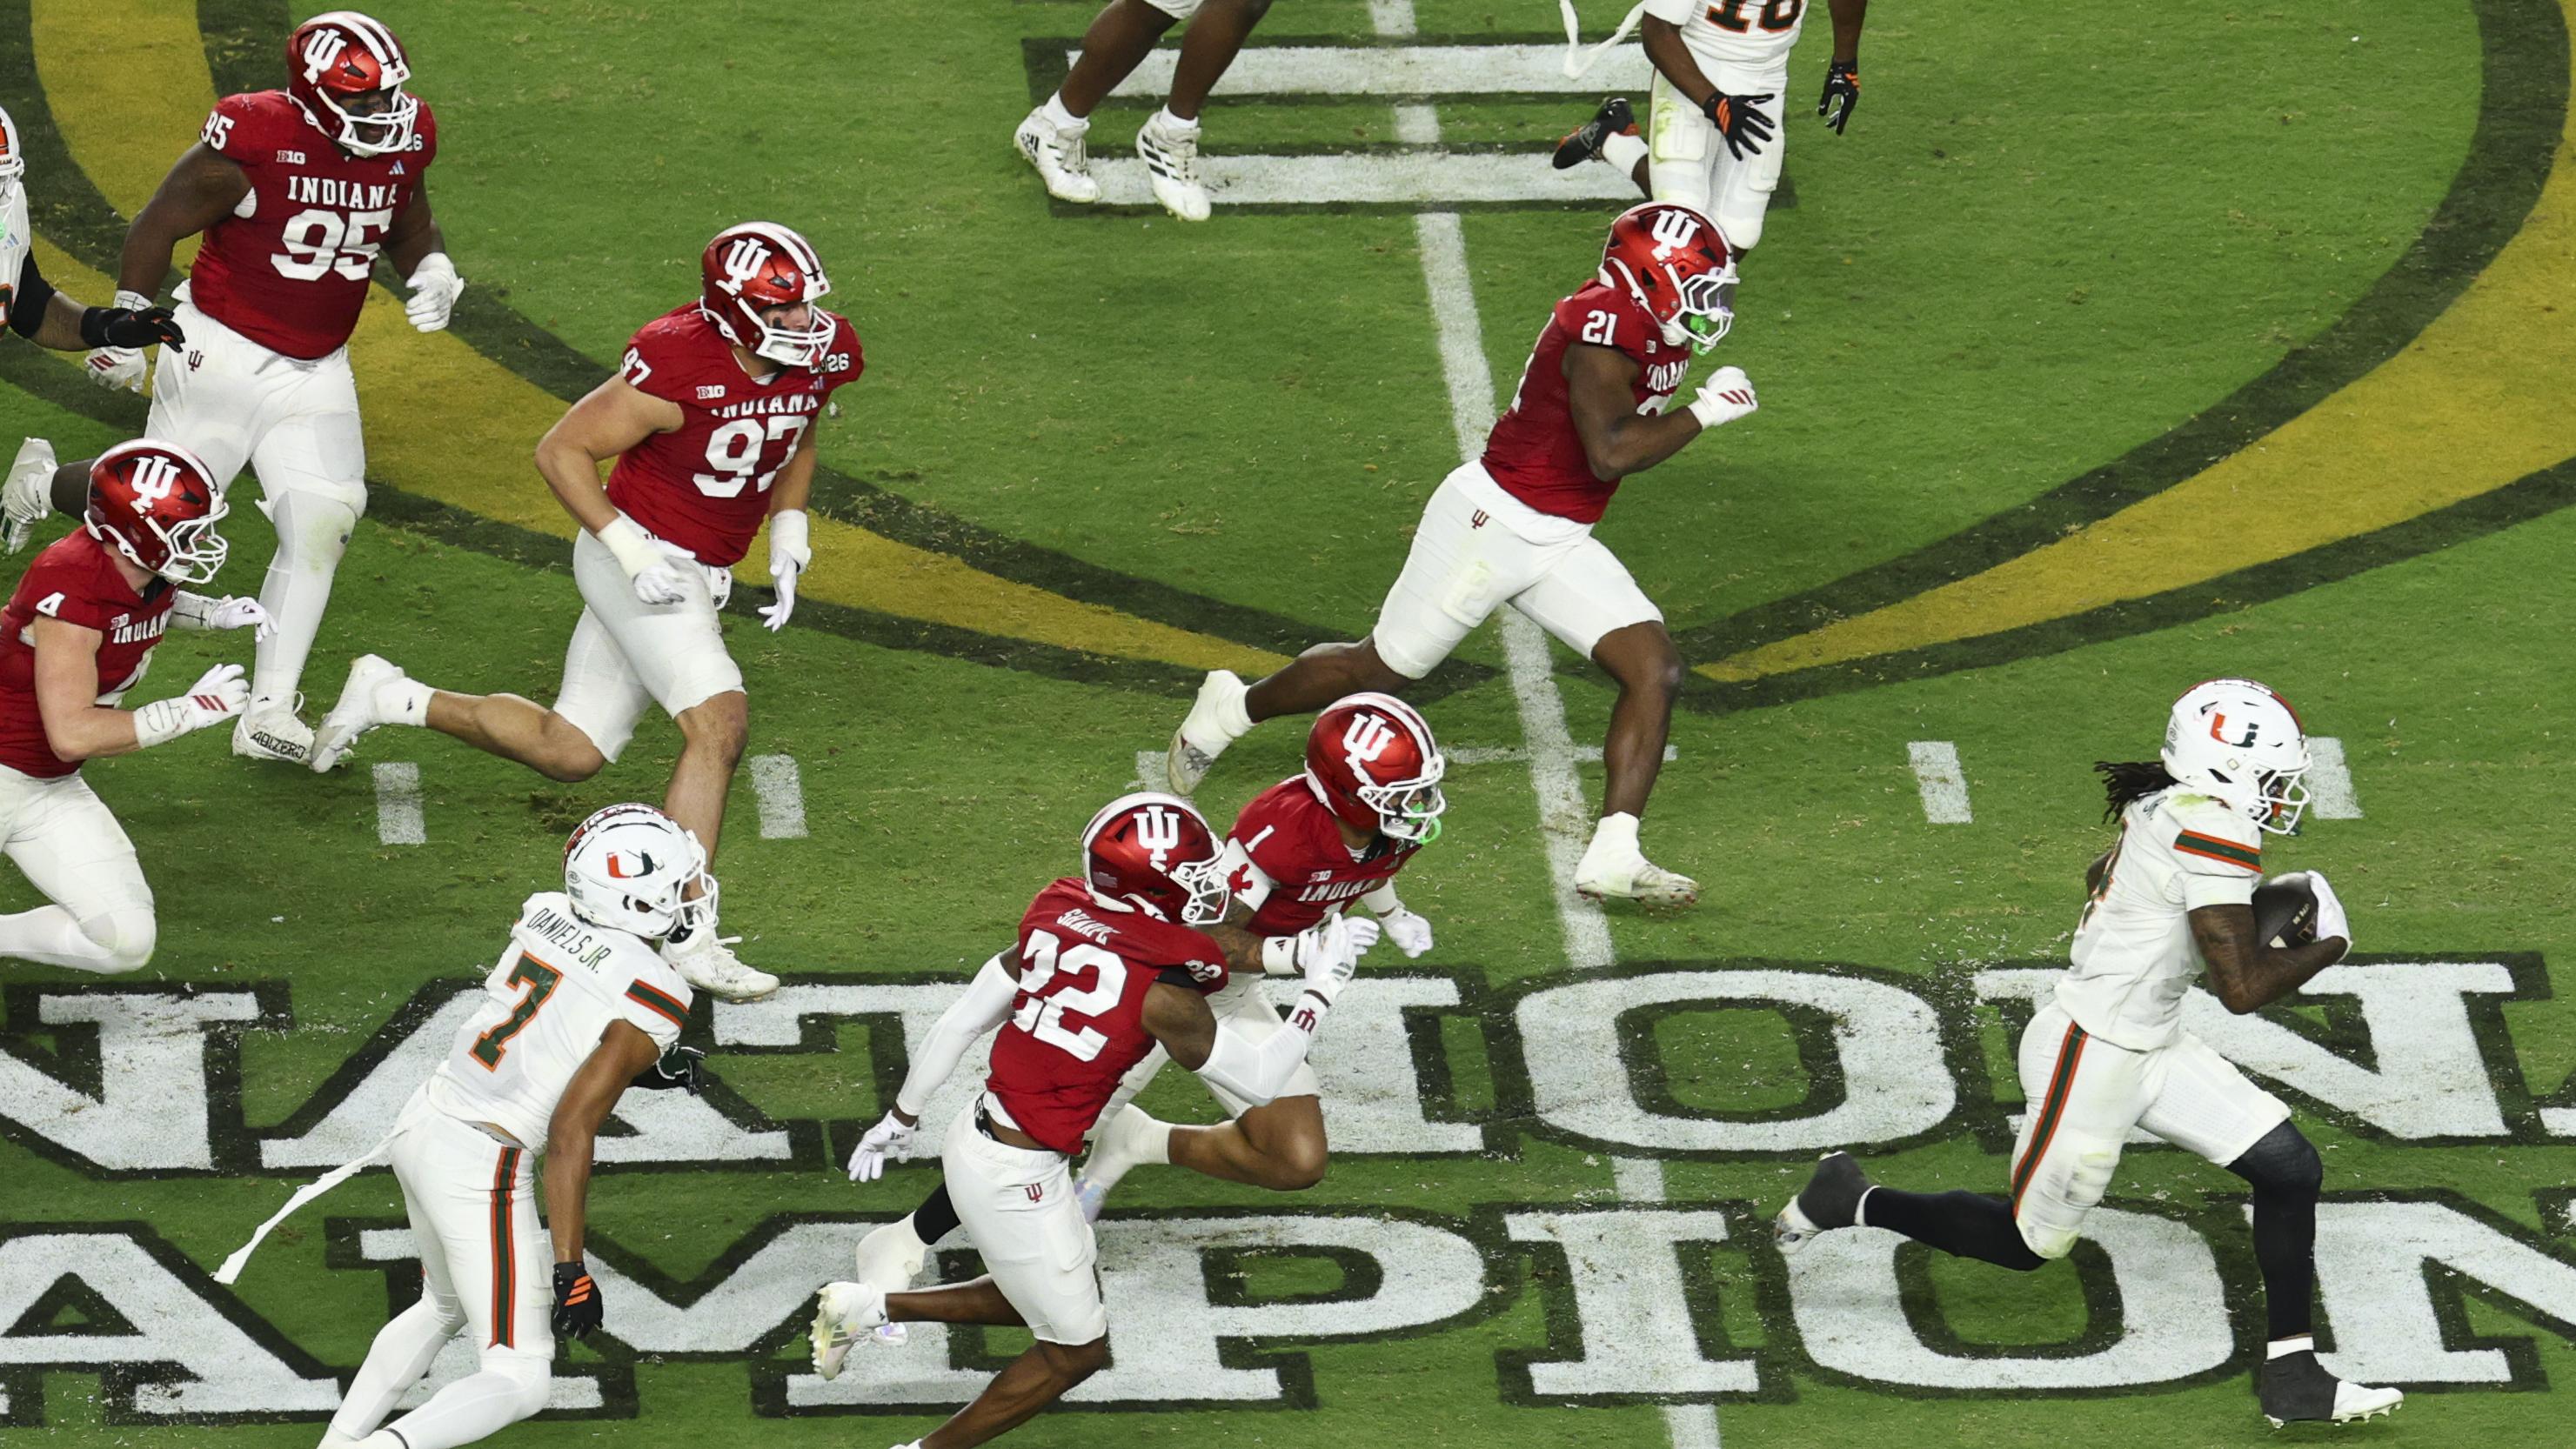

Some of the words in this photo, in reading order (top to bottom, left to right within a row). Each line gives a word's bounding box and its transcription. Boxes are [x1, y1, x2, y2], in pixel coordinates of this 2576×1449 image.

[201, 111, 235, 150] 95
[288, 176, 398, 210] INDIANA
[271, 208, 393, 281] 95
[1582, 310, 1617, 346] 21
[621, 347, 652, 386] 97
[693, 415, 808, 498] 97
[1245, 825, 1275, 852] 1
[526, 907, 592, 955] DANIELS
[579, 943, 612, 974] JR.
[468, 950, 565, 1072] 7
